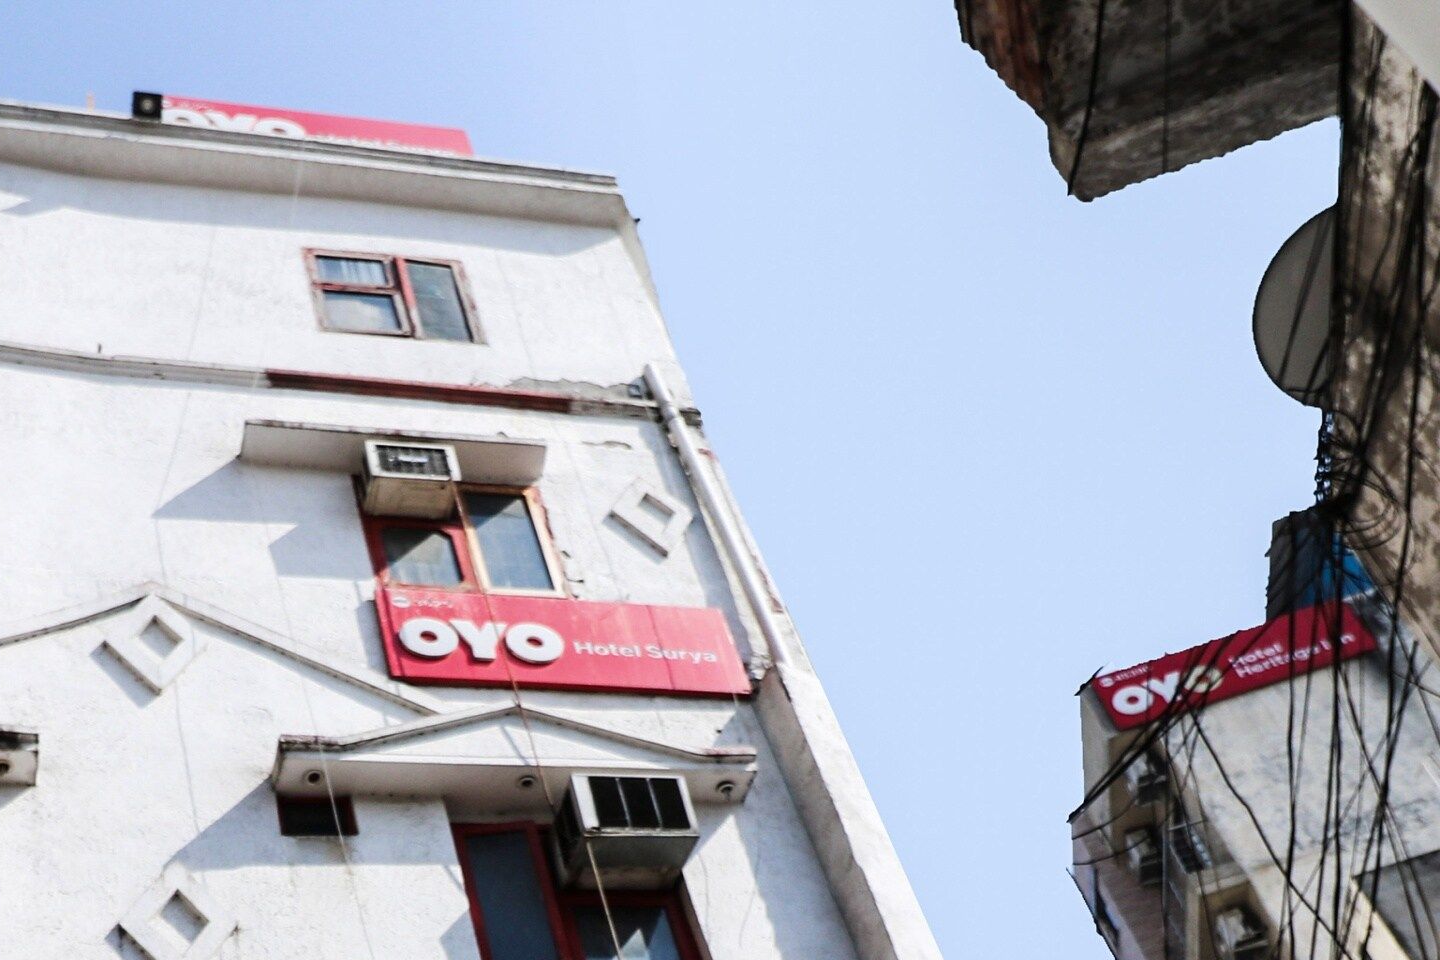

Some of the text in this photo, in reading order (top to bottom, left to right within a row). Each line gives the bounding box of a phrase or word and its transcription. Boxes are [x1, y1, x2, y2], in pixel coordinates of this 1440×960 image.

[398, 616, 565, 664] OYO
[573, 640, 717, 664] Hotel Surya
[1235, 645, 1322, 678] Heritge
